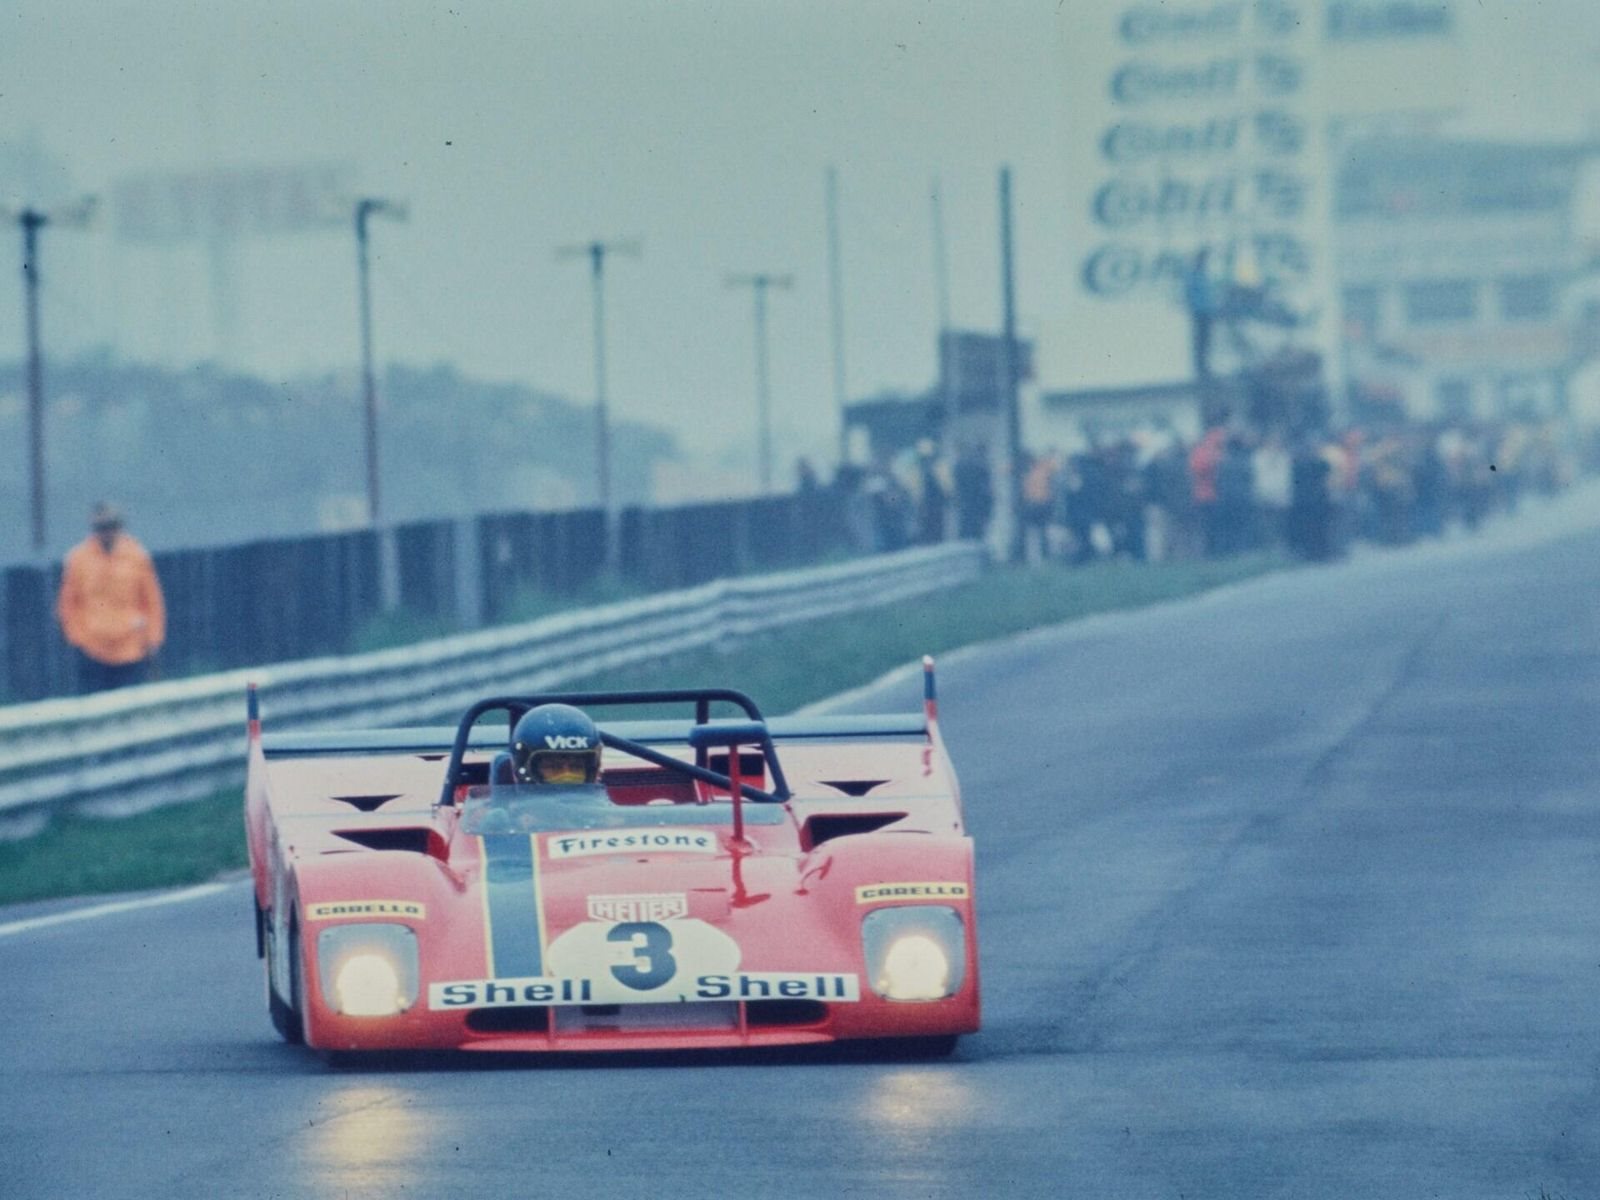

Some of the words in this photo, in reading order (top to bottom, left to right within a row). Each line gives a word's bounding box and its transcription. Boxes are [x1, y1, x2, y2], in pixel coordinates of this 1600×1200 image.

[544, 734, 589, 750] VICK
[556, 833, 709, 853] Firestone
[861, 885, 966, 899] CARELLO
[315, 903, 419, 916] CARELLO
[606, 920, 678, 991] 3
[441, 978, 592, 1006] Shell
[696, 973, 847, 1000] Shell
